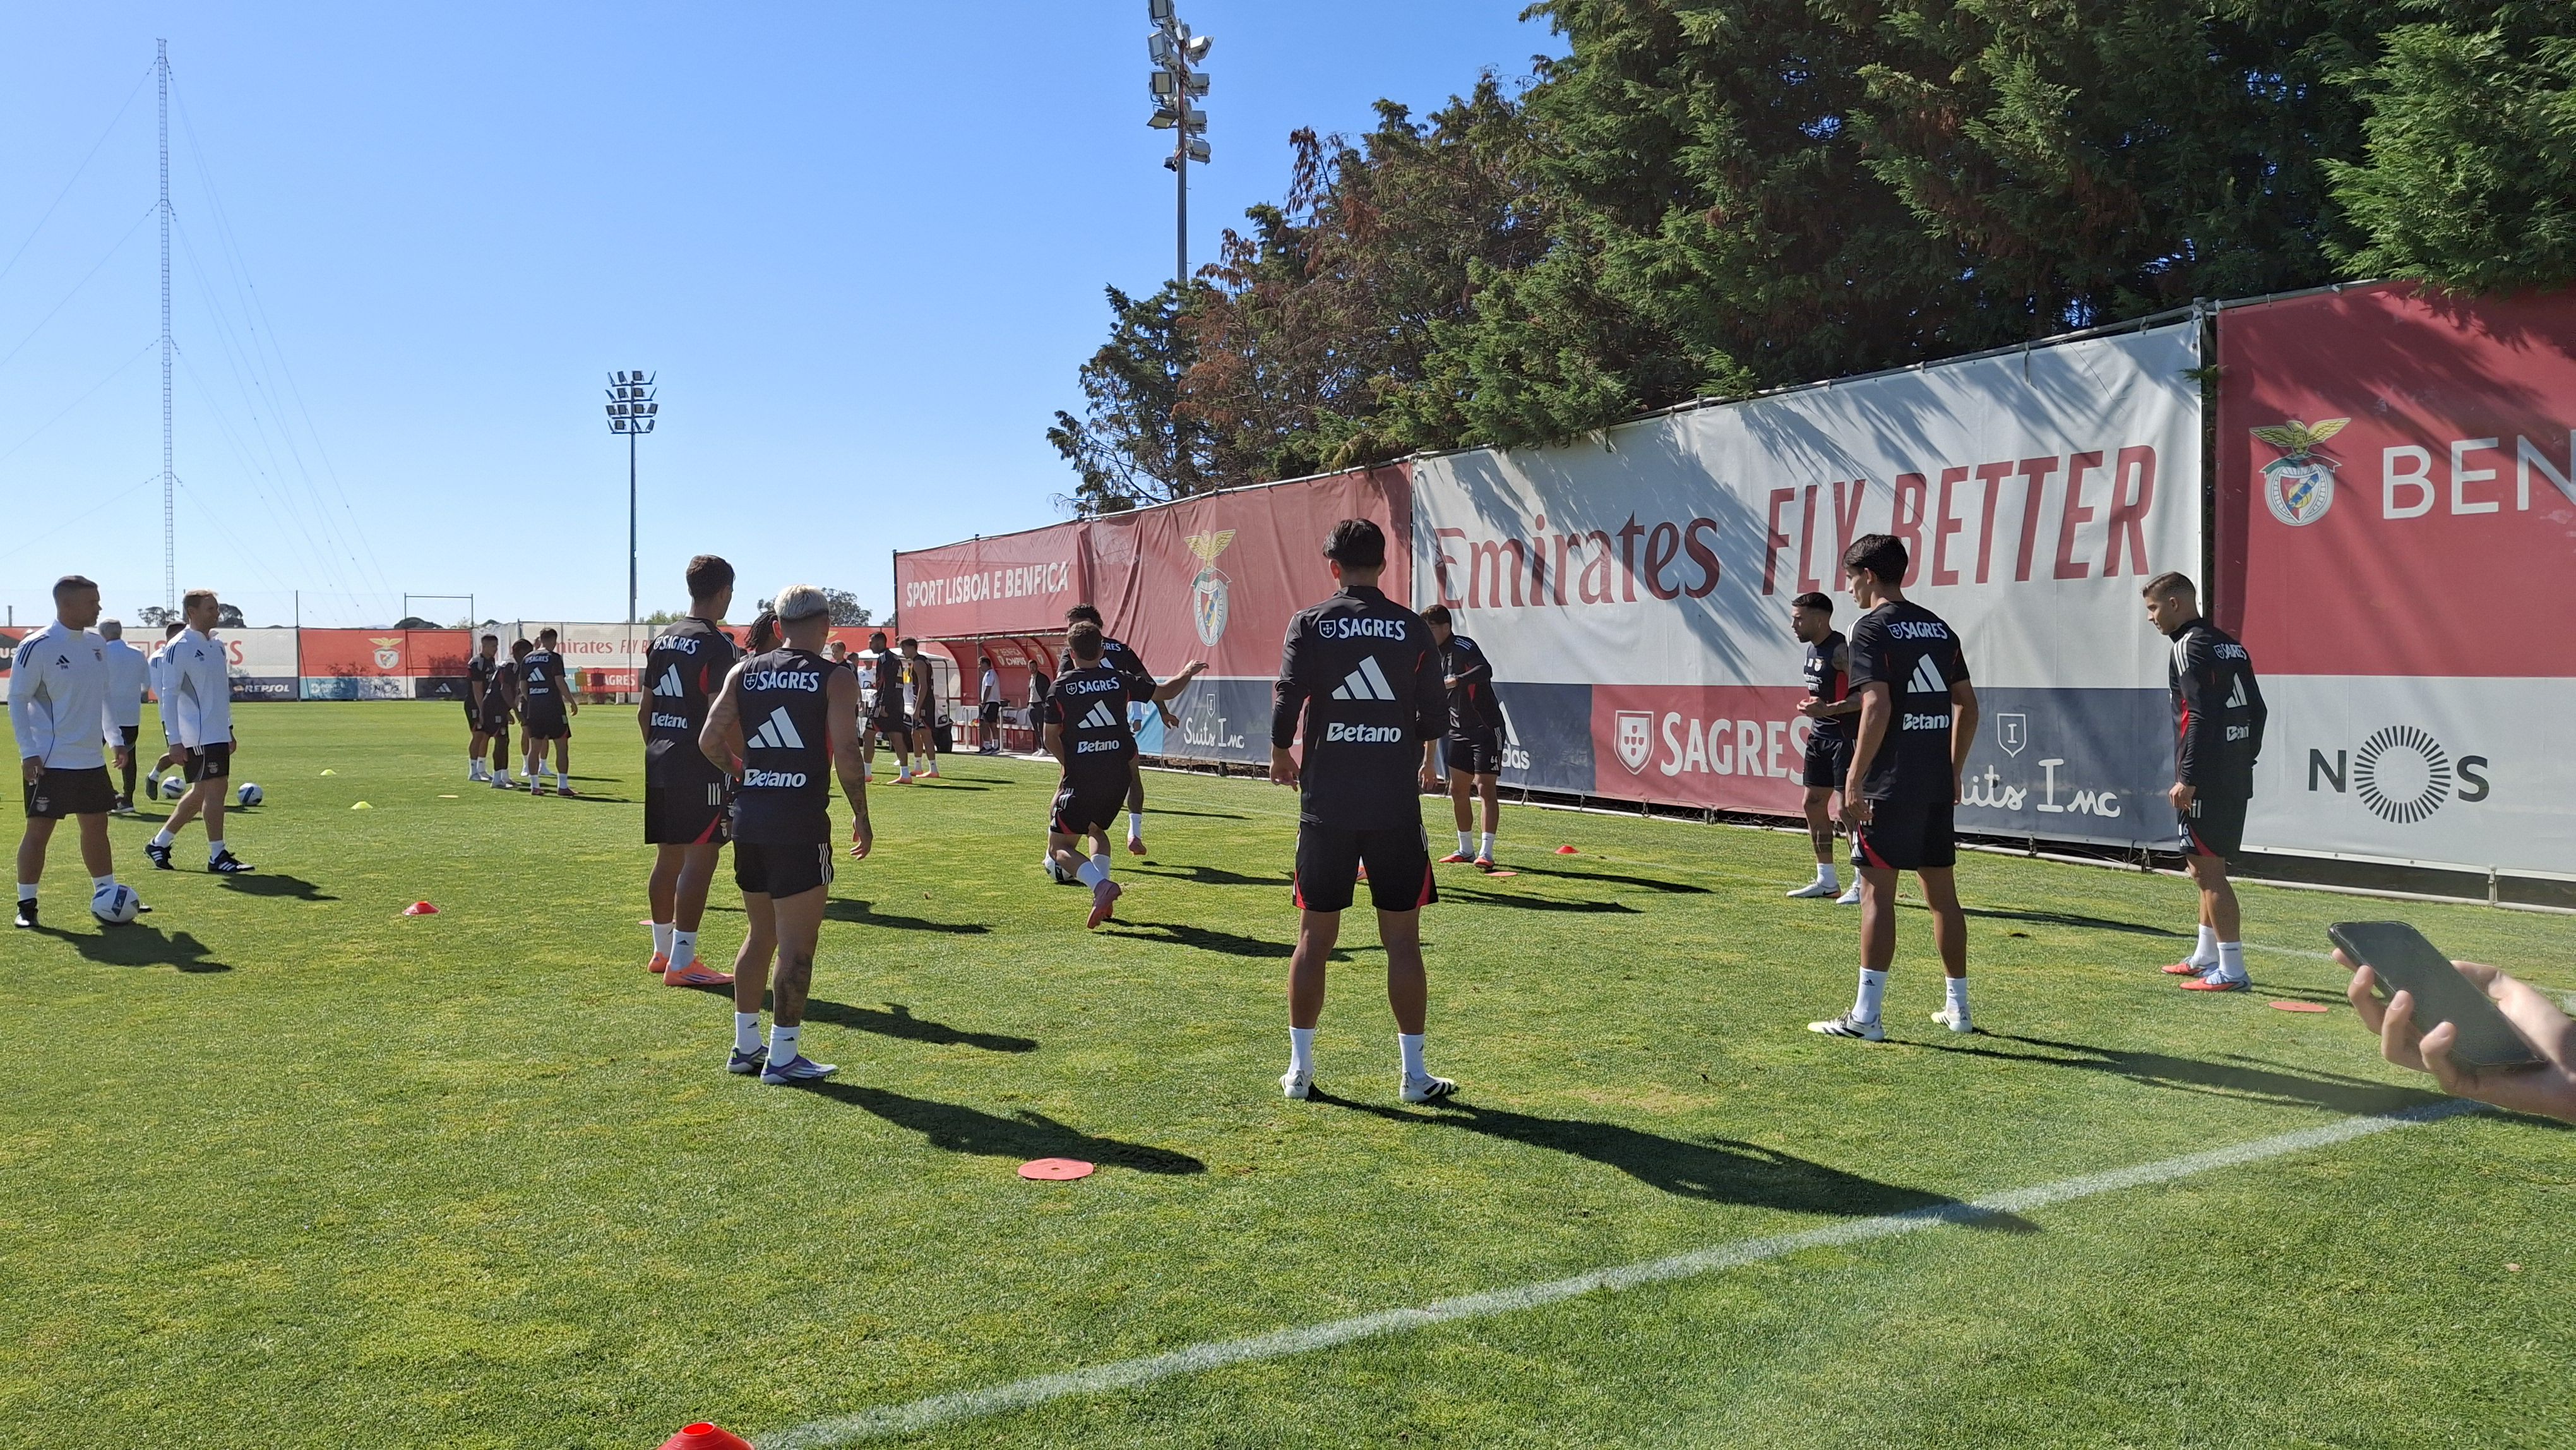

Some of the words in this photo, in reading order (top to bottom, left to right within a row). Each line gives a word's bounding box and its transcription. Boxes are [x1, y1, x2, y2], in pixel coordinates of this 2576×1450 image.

[1434, 510, 1720, 609] Emirates
[1762, 479, 1866, 596] FLY
[1890, 445, 2157, 589] BETTER
[906, 578, 944, 608] SPORT
[945, 572, 990, 604] LISBOA
[993, 570, 1002, 599] E
[1005, 561, 1068, 598] BENFICA
[1338, 617, 1406, 641] SAGRES
[1900, 621, 1948, 640] SAGRES
[659, 635, 700, 656] SAGRES
[244, 684, 290, 693] REPSOL
[605, 674, 636, 686] AGRES
[757, 671, 820, 692] SAGRES
[1078, 676, 1120, 694] SAGRES
[1184, 717, 1216, 748] Suits
[1217, 717, 1245, 749] Inc
[1326, 722, 1402, 743] Betano
[1077, 739, 1120, 753] Betano
[1660, 712, 1813, 786] SAGRES
[743, 769, 807, 788] Betano
[2308, 725, 2490, 824] NOS
[1961, 764, 2027, 811] uits
[2036, 758, 2121, 818] Inc
